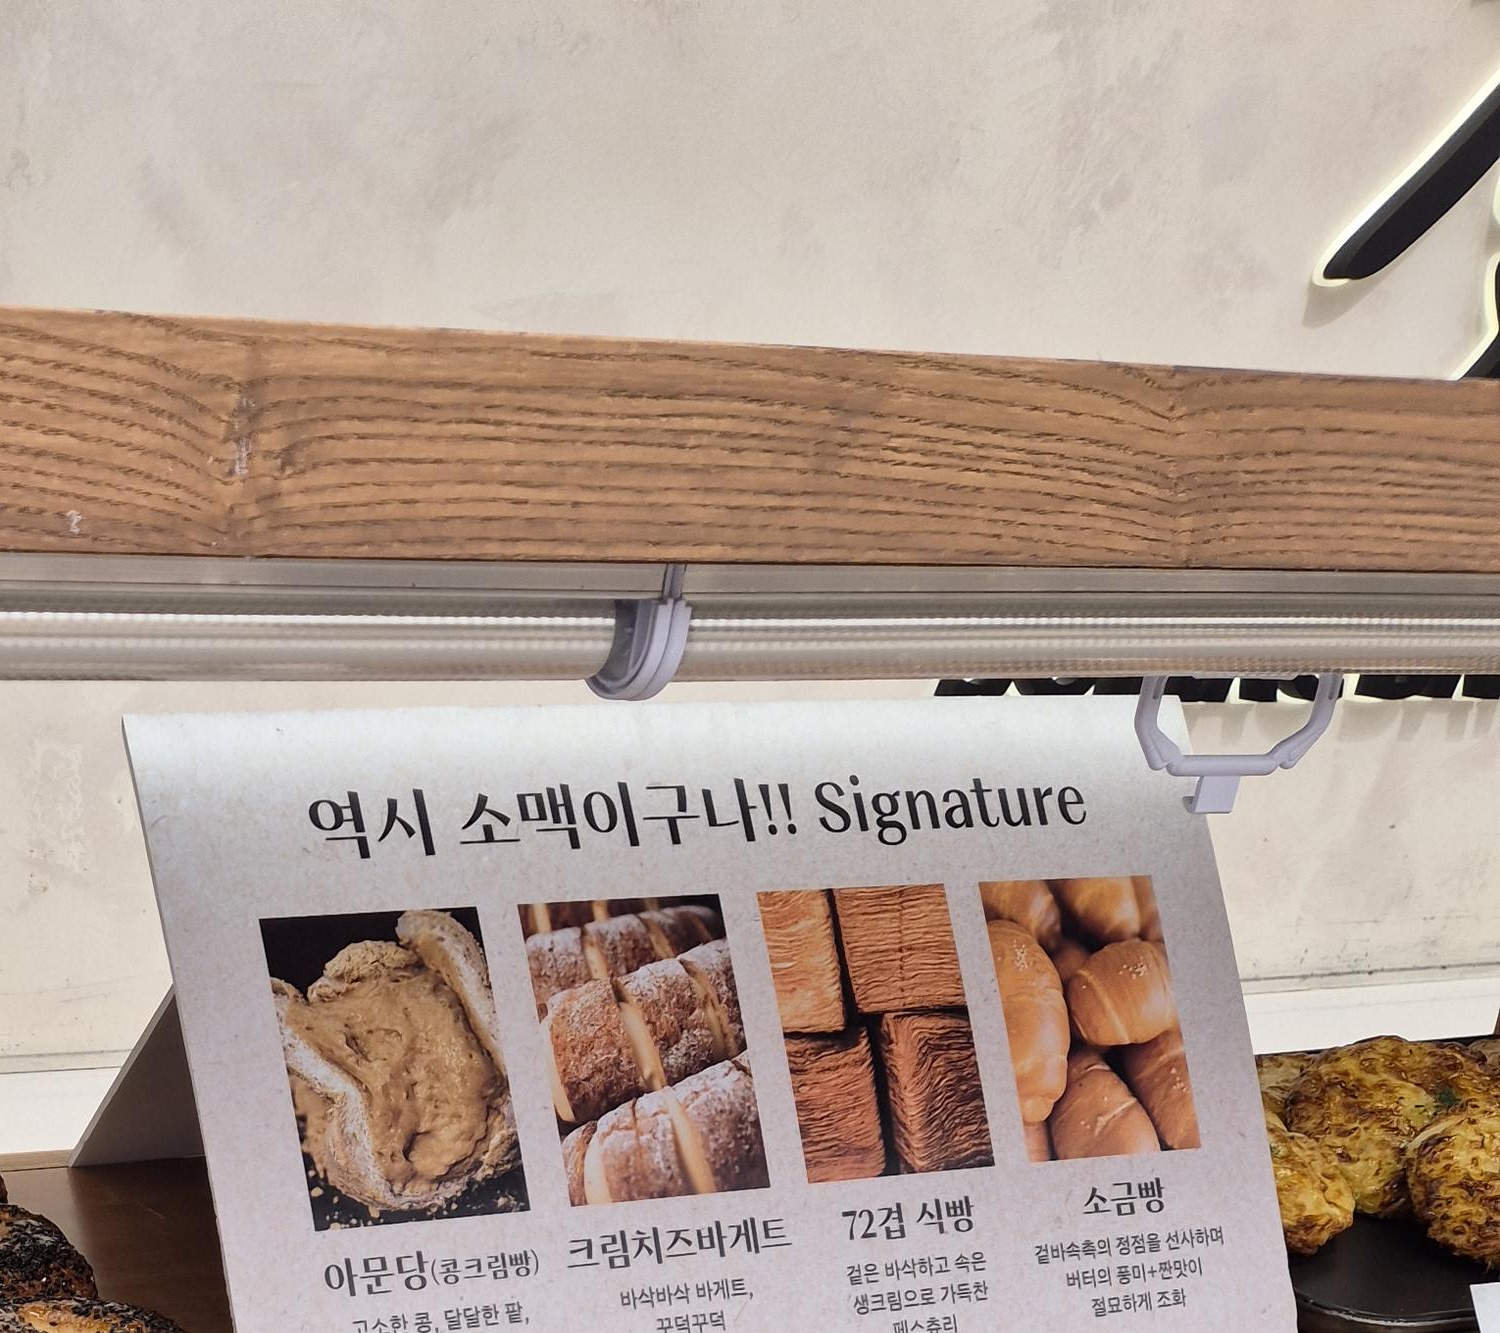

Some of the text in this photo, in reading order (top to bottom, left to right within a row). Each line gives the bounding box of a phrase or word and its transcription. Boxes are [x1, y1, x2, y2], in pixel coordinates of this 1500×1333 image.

[307, 775, 1087, 859] 역시 소맥이구나!! Signature
[1083, 1177, 1165, 1217] 소금빵
[841, 1195, 975, 1242] 72겹 식빵
[566, 1216, 793, 1270] 크림치즈바게트
[1115, 1231, 1161, 1255] 정점을
[1165, 1226, 1225, 1251] 선사하며
[324, 1248, 540, 1298] 아문당(콩크림빵)
[846, 1251, 987, 1287] 겉은 바삭하고 속은
[1065, 1256, 1203, 1289] 버터의 풍미+짠맛이
[620, 1277, 754, 1310] 바삭바삭 바게트,
[852, 1280, 989, 1316] 생크림으로 가득찬
[1091, 1287, 1187, 1317] 절묘하게 조화
[443, 1305, 500, 1331] 달달한
[503, 1301, 531, 1325] 팥,
